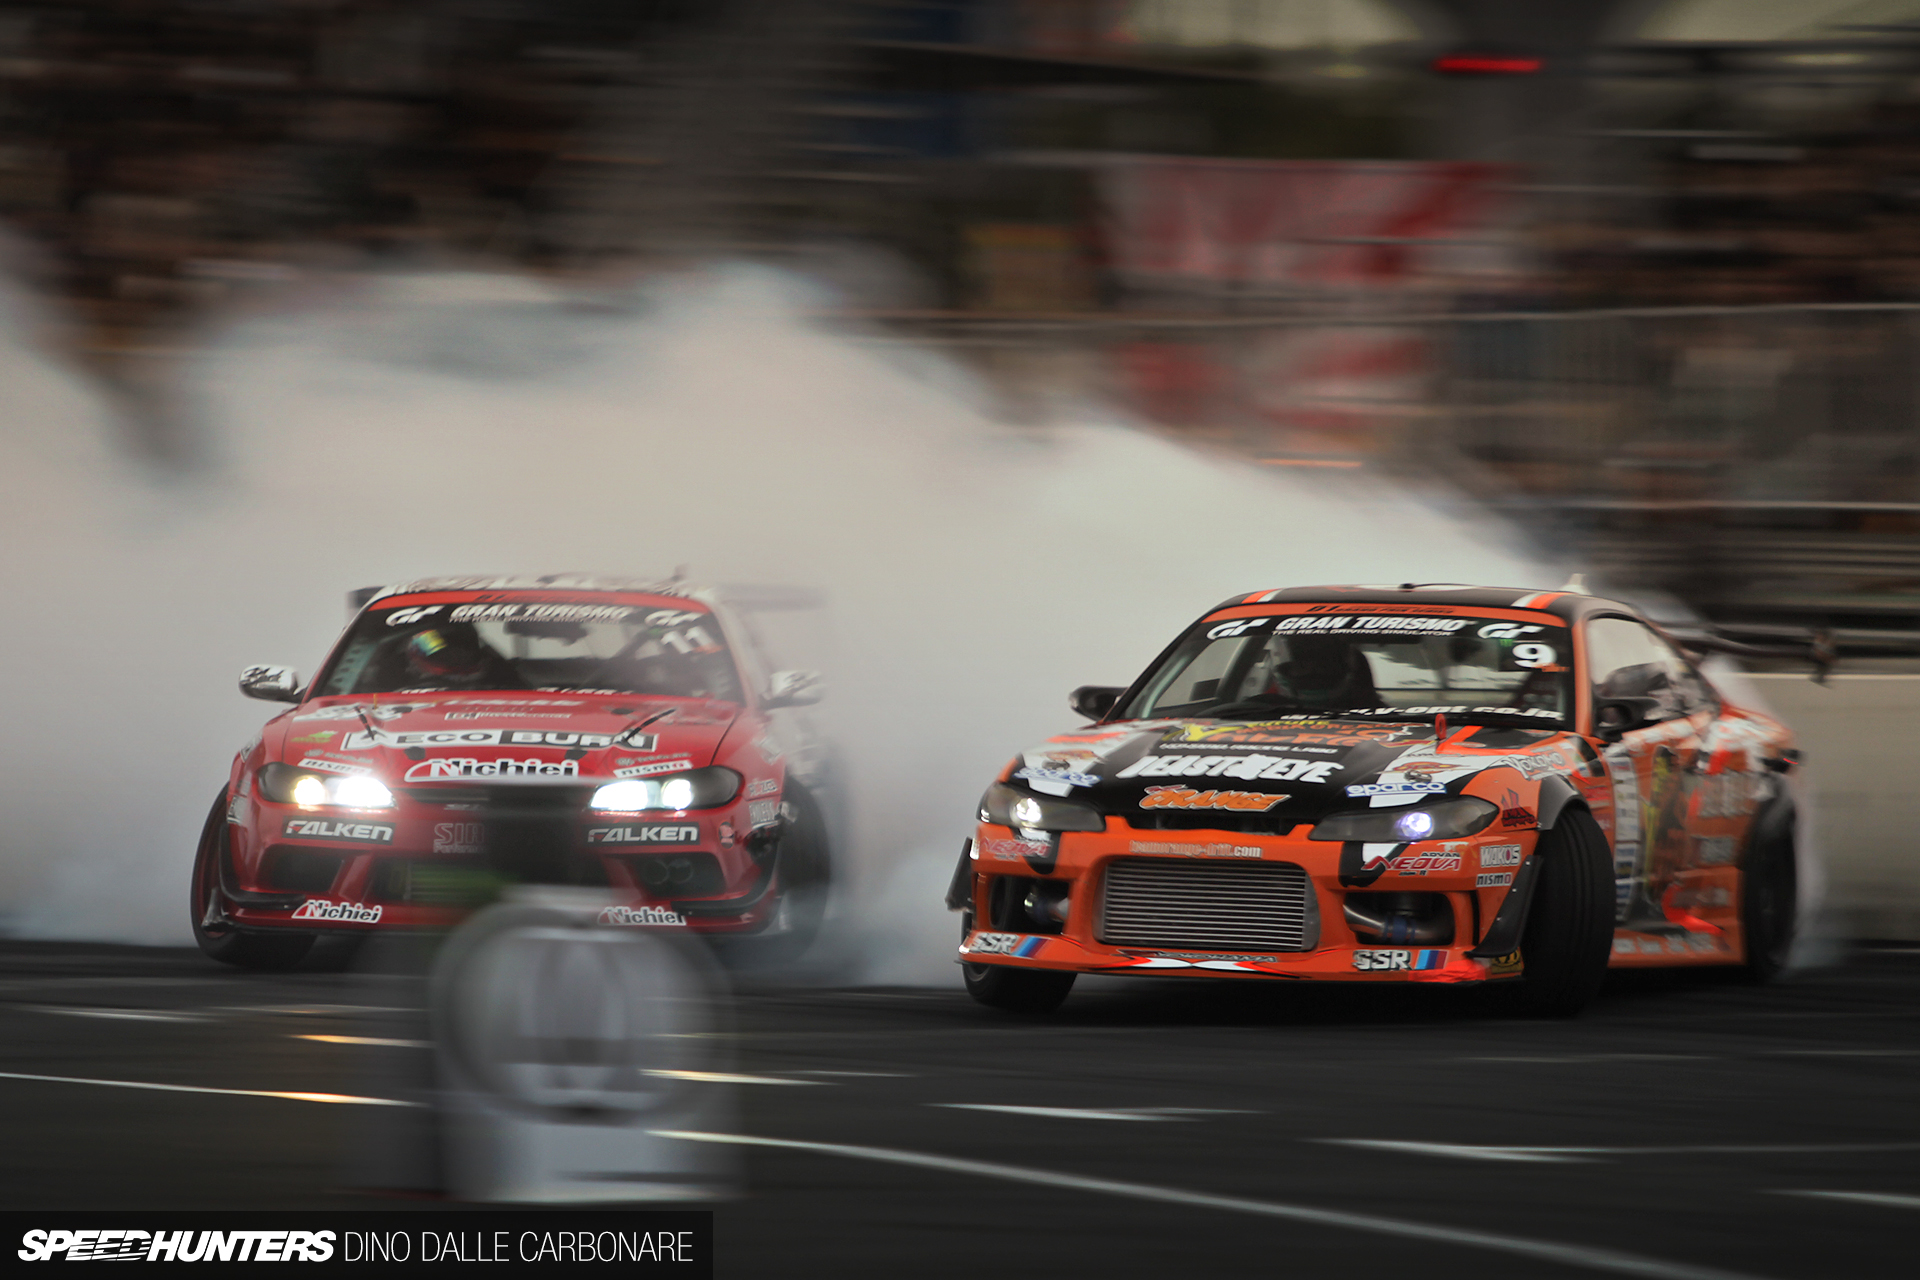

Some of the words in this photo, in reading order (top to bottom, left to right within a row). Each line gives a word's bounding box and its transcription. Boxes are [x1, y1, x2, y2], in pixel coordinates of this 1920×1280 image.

[451, 604, 523, 617] GRAN
[523, 604, 635, 619] TURISMO
[1274, 617, 1352, 631] GRAN
[1351, 617, 1467, 631] TURISMO
[661, 626, 717, 654] 11
[1512, 643, 1557, 668] 9
[397, 732, 494, 744] ECO
[511, 731, 646, 748] BURN
[418, 758, 579, 779] Nichiei
[1347, 781, 1446, 796] sparco
[286, 820, 393, 841] FALKEN
[588, 826, 698, 842] FALKEN
[1361, 855, 1462, 870] NEOVA
[298, 900, 382, 922] Nichiei
[969, 932, 1019, 953] SSR
[1353, 950, 1412, 971] SSR
